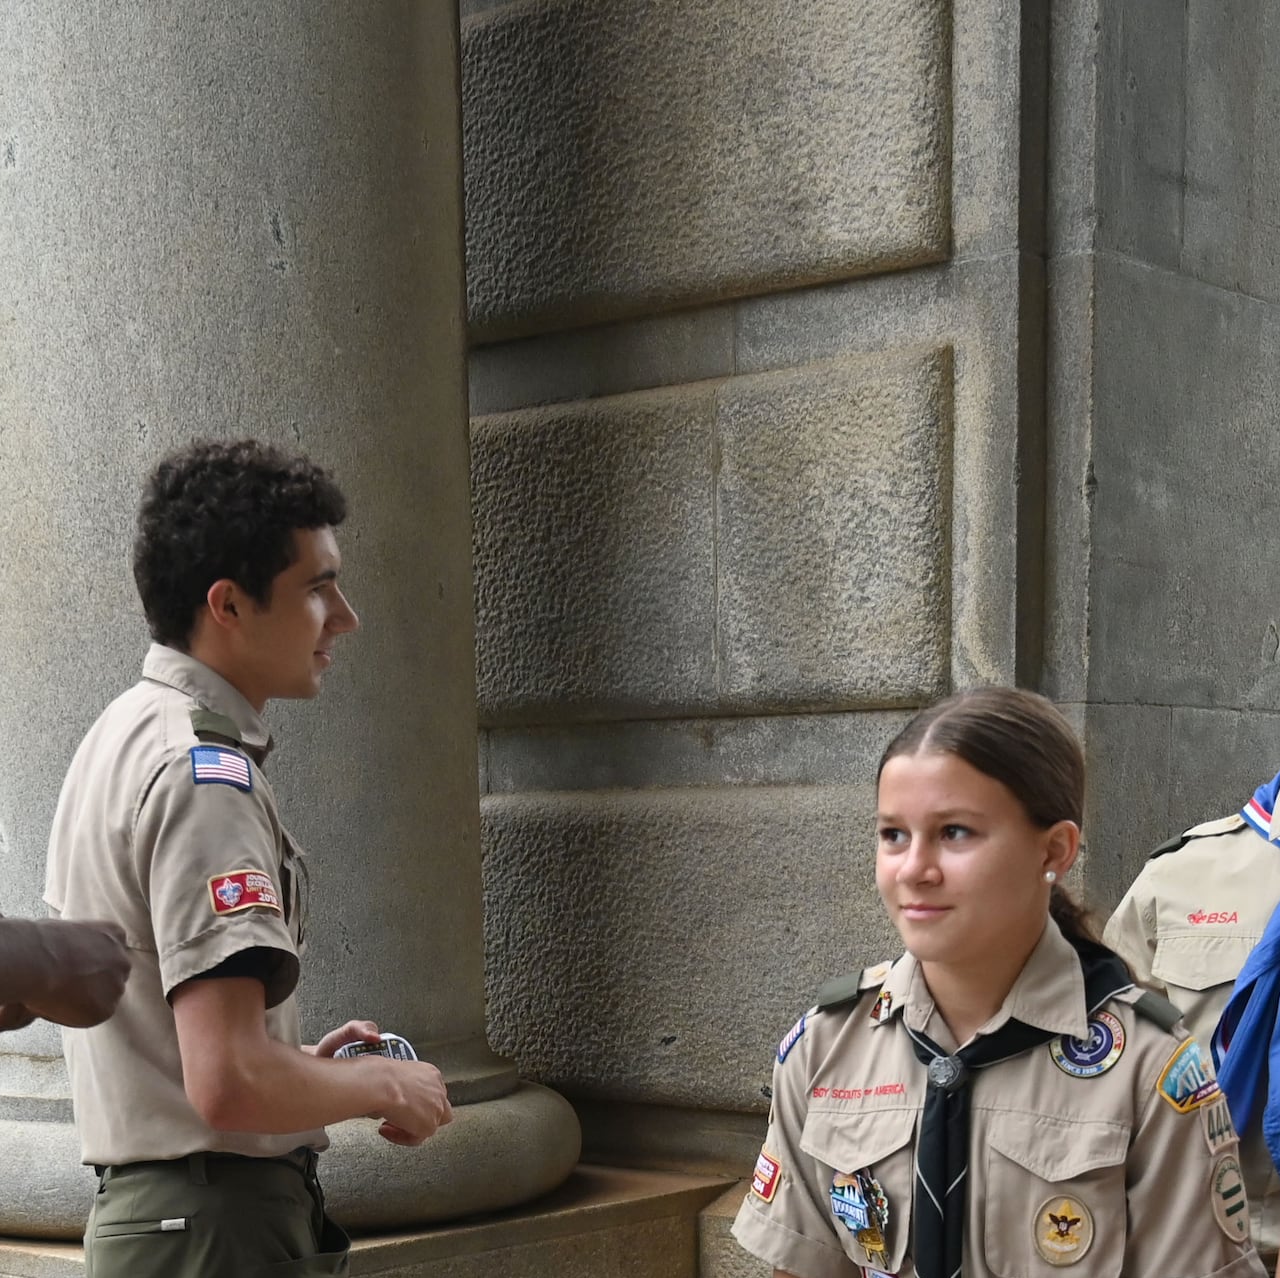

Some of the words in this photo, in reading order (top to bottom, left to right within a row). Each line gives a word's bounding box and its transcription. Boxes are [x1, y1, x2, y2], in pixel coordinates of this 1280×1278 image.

[1206, 911, 1239, 924] BSA
[812, 1087, 830, 1098] BOY
[831, 1088, 862, 1100] SCOUTS
[874, 1083, 905, 1096] AMERICA
